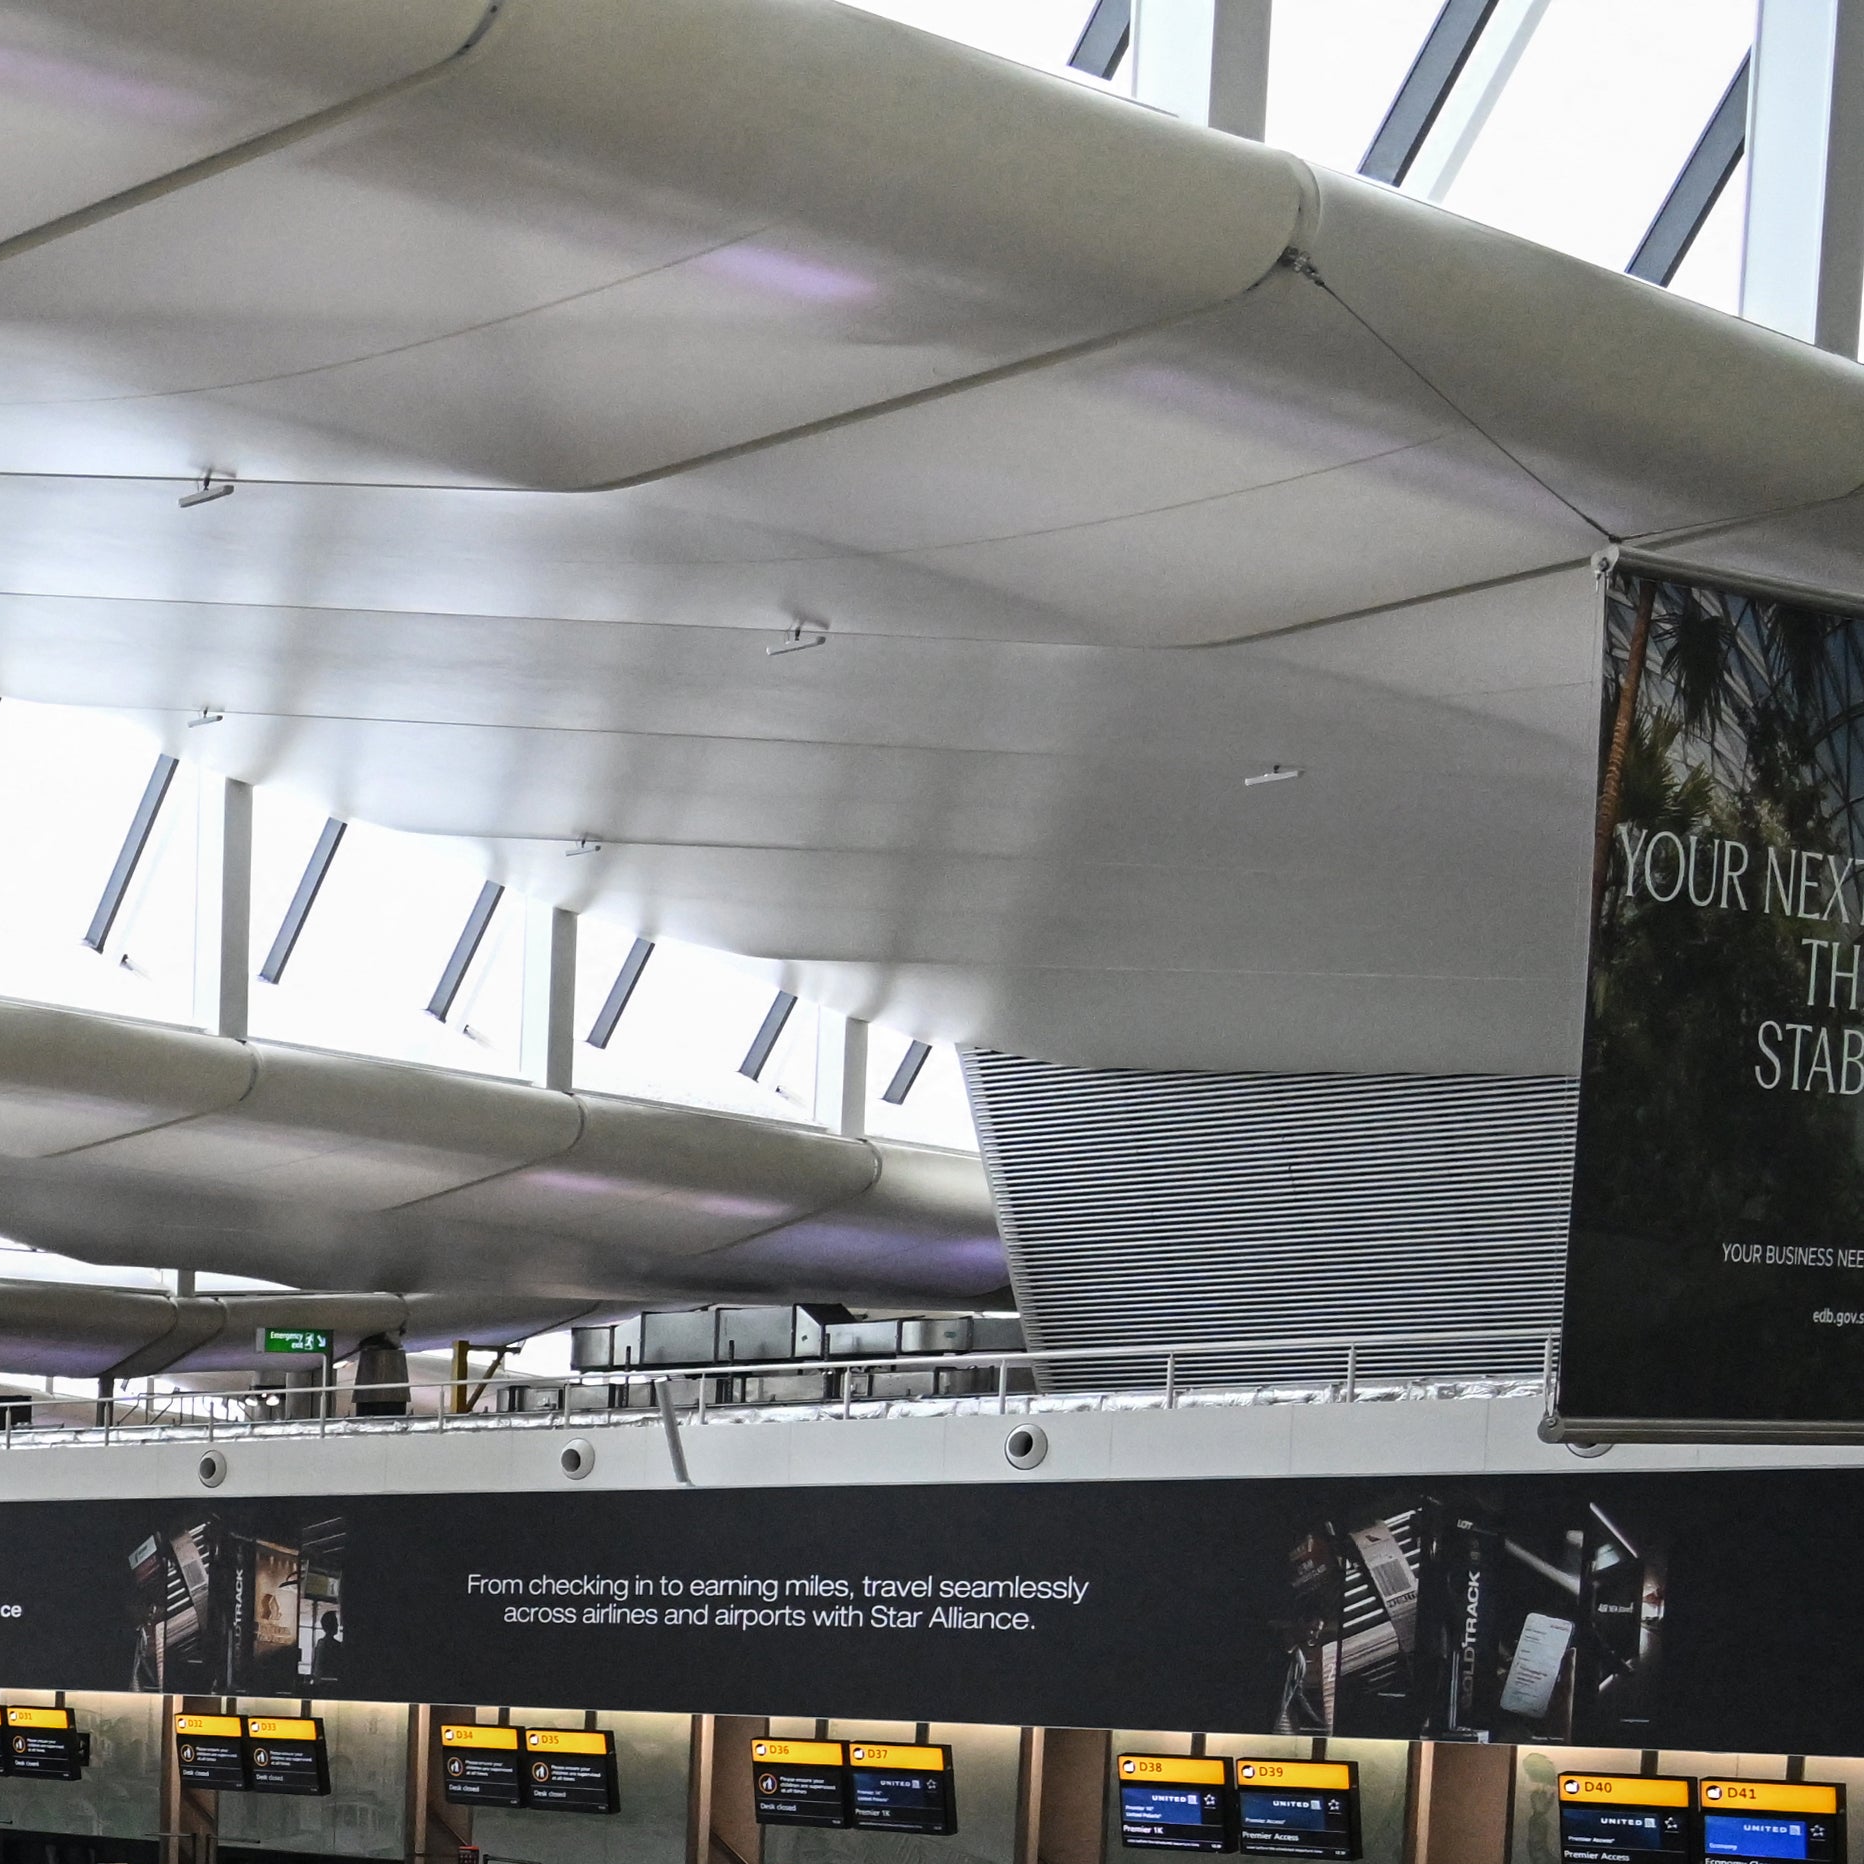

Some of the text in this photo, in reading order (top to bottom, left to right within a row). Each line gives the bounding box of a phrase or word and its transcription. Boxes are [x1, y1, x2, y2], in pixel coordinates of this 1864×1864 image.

[1616, 822, 1749, 911] YOUR
[1755, 1020, 1864, 1095] STAB
[1722, 1243, 1864, 1268] YOUR BUSINESS NEE
[1813, 1307, 1864, 1327] edb.gov.s
[467, 1574, 1089, 1604] From checking in to earning miles, travel seamlessly
[504, 1604, 1035, 1630] across airlines and airports with Star Alliance.
[457, 1731, 472, 1739] D34
[542, 1736, 559, 1744] D35
[769, 1745, 789, 1754] D36
[868, 1750, 887, 1758] D37
[1139, 1762, 1162, 1772] D38
[1259, 1767, 1283, 1777] D39
[1585, 1781, 1612, 1793] D40
[1727, 1787, 1756, 1799] D41
[1152, 1795, 1186, 1803] UNITED
[1273, 1800, 1309, 1808] UNITED
[761, 1803, 775, 1811] Desk
[855, 1809, 879, 1817] Premier
[1600, 1818, 1642, 1826] UNITED
[1123, 1825, 1163, 1834] Premier 1K
[1744, 1824, 1787, 1834] UNITED
[1242, 1831, 1298, 1841] Premier Access
[1564, 1850, 1630, 1861] Premier Access
